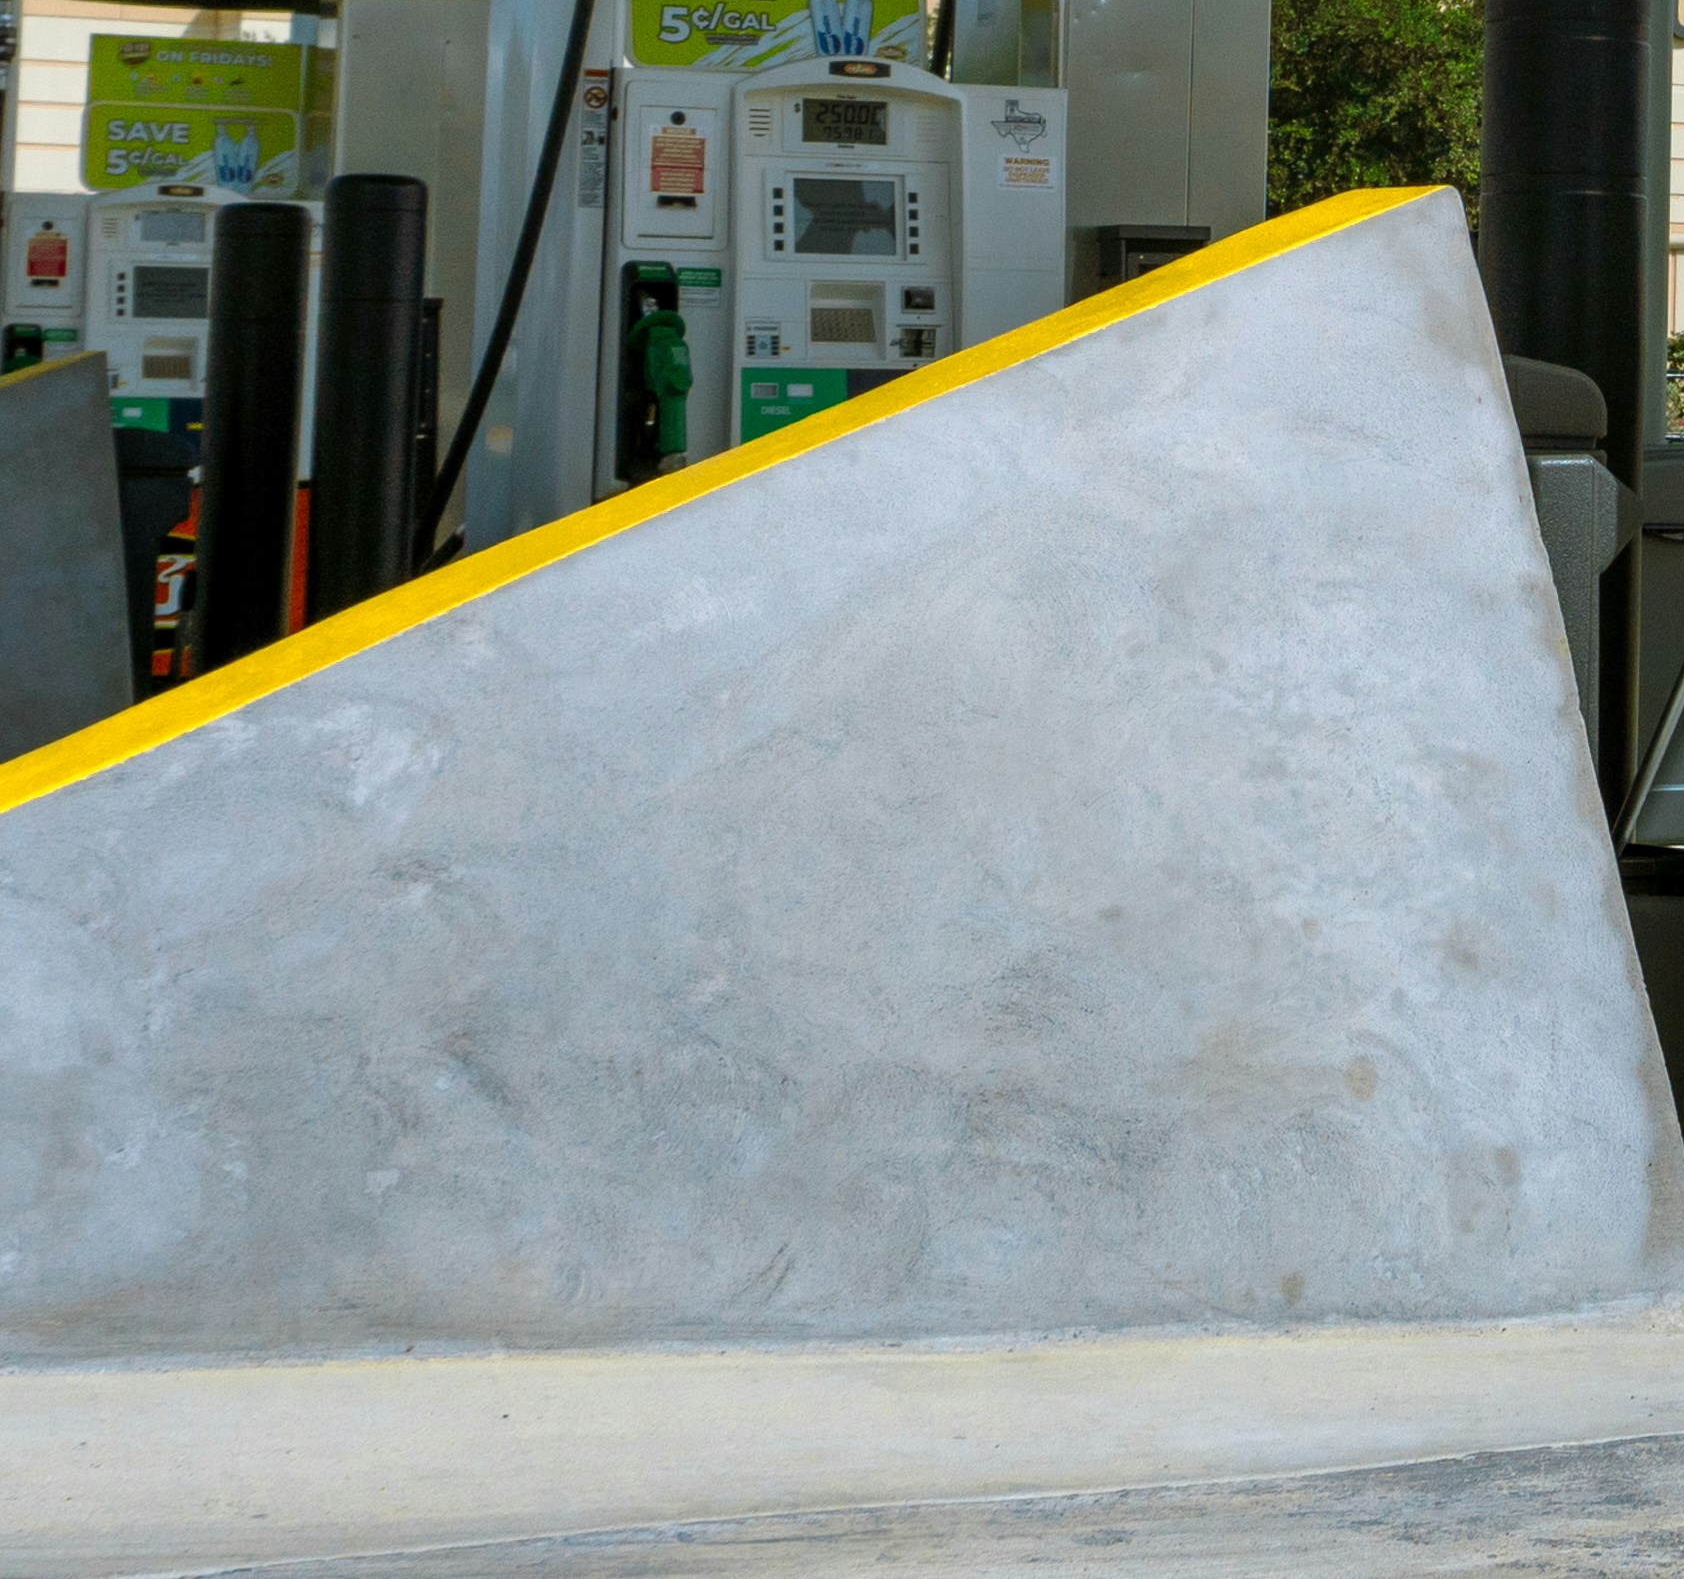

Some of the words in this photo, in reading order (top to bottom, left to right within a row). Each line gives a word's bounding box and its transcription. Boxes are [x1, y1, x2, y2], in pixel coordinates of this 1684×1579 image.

[658, 3, 776, 43] 5¢/GAL
[156, 51, 184, 62] ON
[107, 119, 189, 144] SAVE
[761, 405, 791, 416] DIESEL
